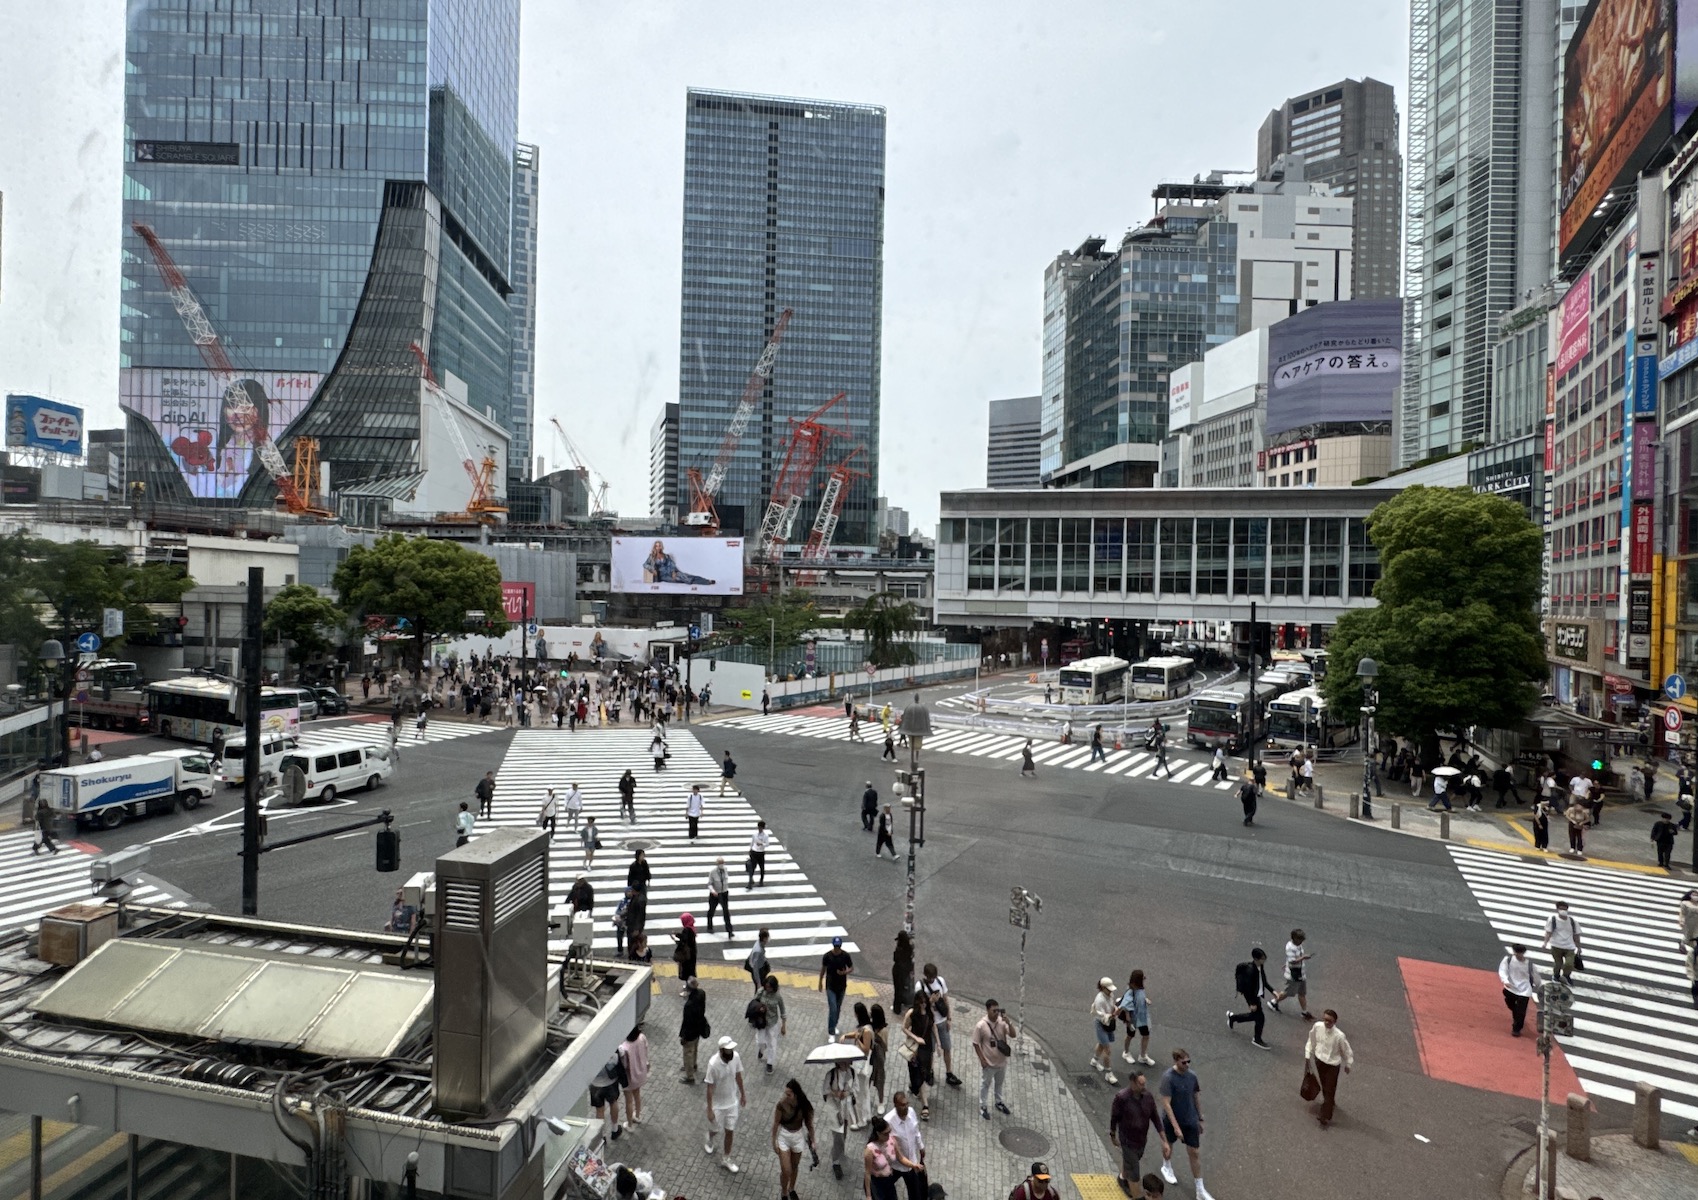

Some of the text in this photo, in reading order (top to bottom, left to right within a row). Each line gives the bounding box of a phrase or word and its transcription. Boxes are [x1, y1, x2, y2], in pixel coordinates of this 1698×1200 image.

[155, 144, 192, 152] SHIBUYA
[155, 152, 236, 162] SCRAMBLE SQUARE
[1642, 277, 1654, 325] 献血ルーム
[1669, 326, 1679, 348] 7F
[1281, 353, 1389, 380] ヘアケアの答え。
[162, 378, 207, 387] 夢を叶える
[276, 377, 313, 390] バイトル
[162, 388, 189, 397] 仕事に
[162, 411, 206, 426] dip AI
[1638, 437, 1650, 487] 品川美容外科
[1485, 470, 1514, 482] SHIBUYA
[1472, 475, 1531, 494] MARK CITY
[1637, 506, 1649, 543] 外貨両替
[1556, 626, 1585, 648] サンドラッグ
[81, 773, 132, 788] Shokuryu
